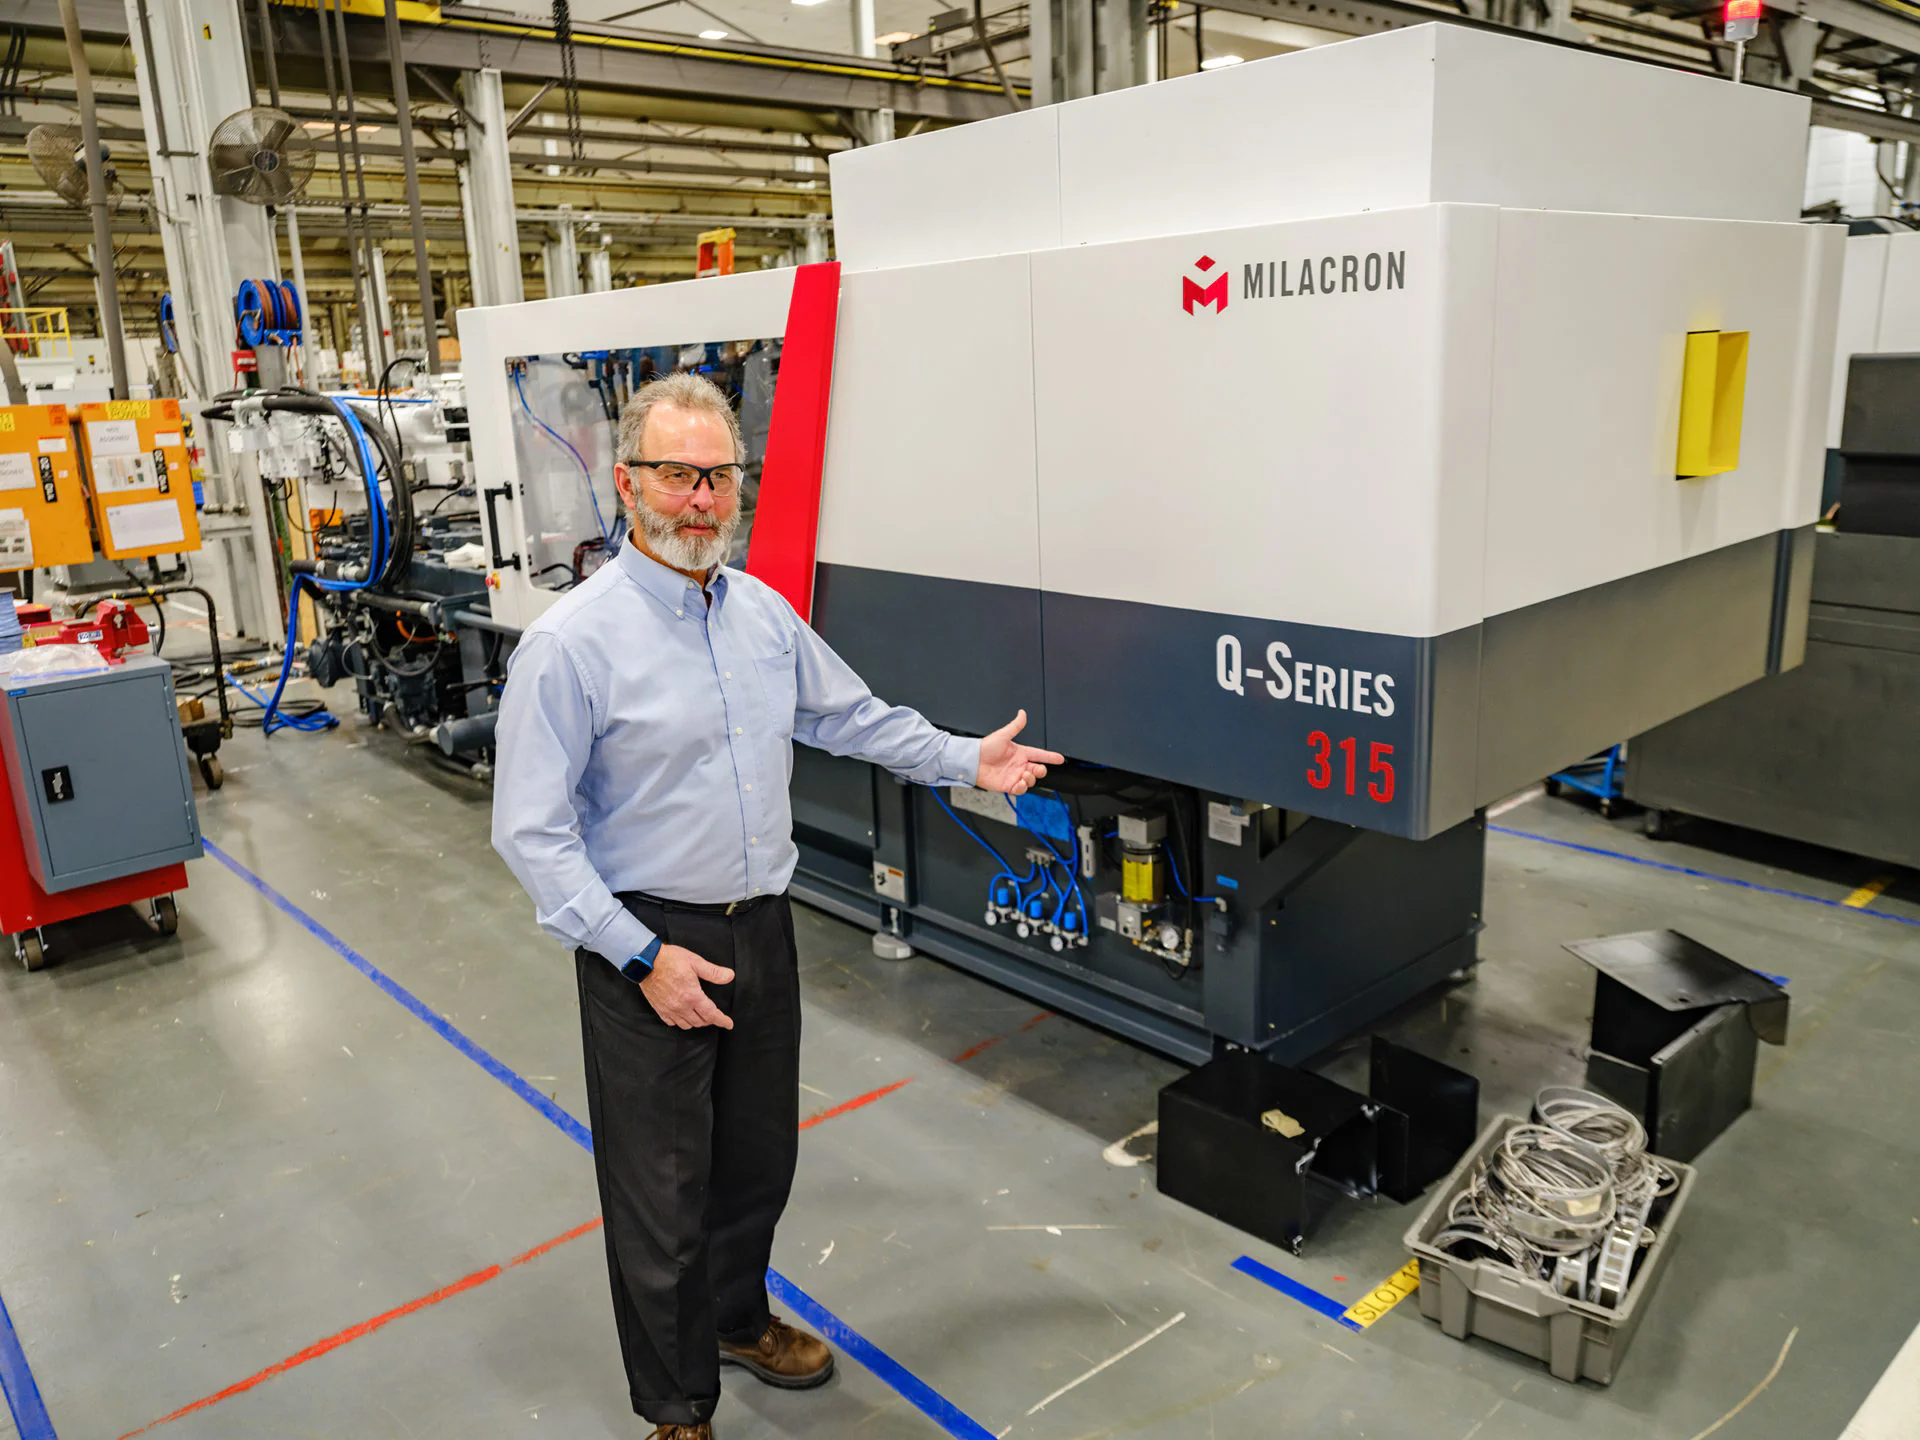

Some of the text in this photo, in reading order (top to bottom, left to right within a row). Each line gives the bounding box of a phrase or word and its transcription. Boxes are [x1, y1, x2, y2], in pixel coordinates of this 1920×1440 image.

[1244, 250, 1406, 299] MILACRON
[1306, 730, 1395, 803] 315
[1352, 1275, 1407, 1321] SLOT
